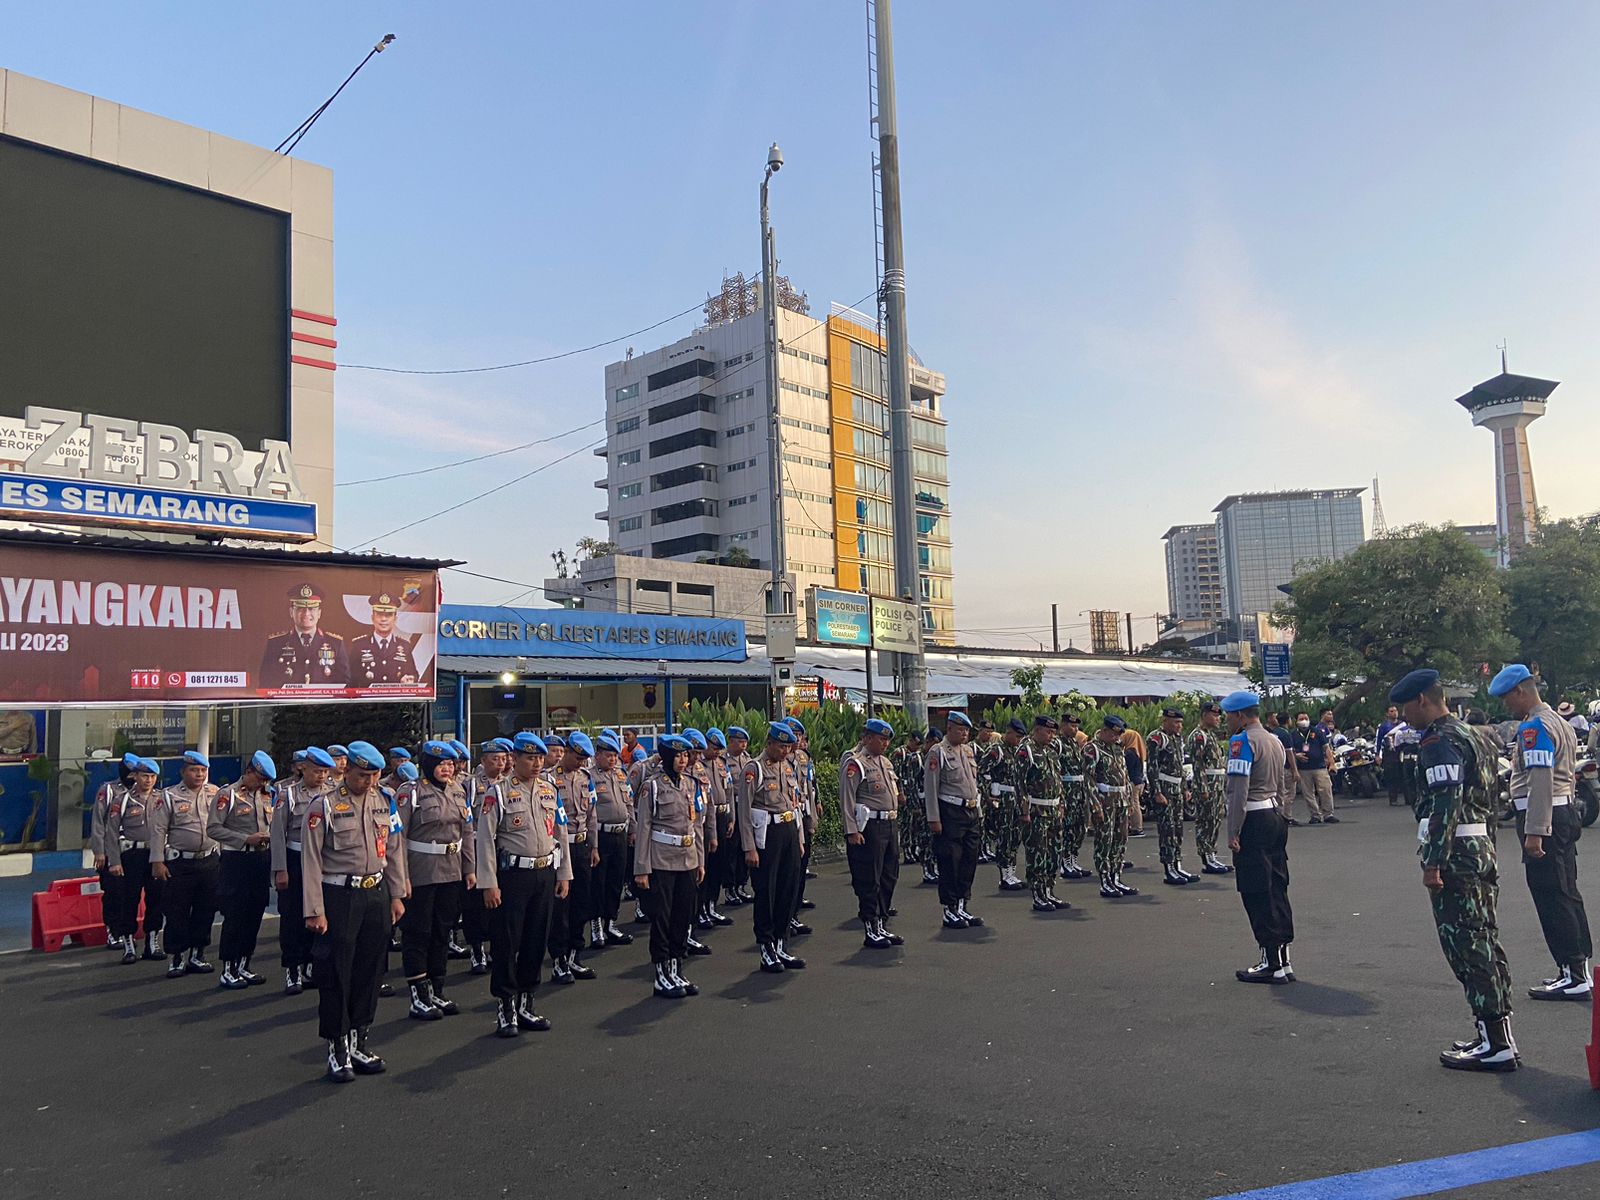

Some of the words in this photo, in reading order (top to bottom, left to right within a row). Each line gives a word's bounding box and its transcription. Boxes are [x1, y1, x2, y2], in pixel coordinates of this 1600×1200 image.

[25, 406, 306, 500] ZEBRA
[2, 481, 48, 507] ES
[61, 487, 249, 525] SEMARANG
[0, 577, 242, 628] YANGKARA
[818, 599, 833, 609] SIM
[835, 601, 866, 614] CORNER
[875, 606, 902, 620] POLISI
[440, 619, 521, 641] CORNER
[526, 623, 650, 645] POLRESTABES
[655, 627, 738, 648] SEMARANG
[832, 630, 857, 639] SEMARANG
[875, 620, 902, 632] POLICE
[20, 633, 70, 652] 2023
[132, 674, 160, 686] 110
